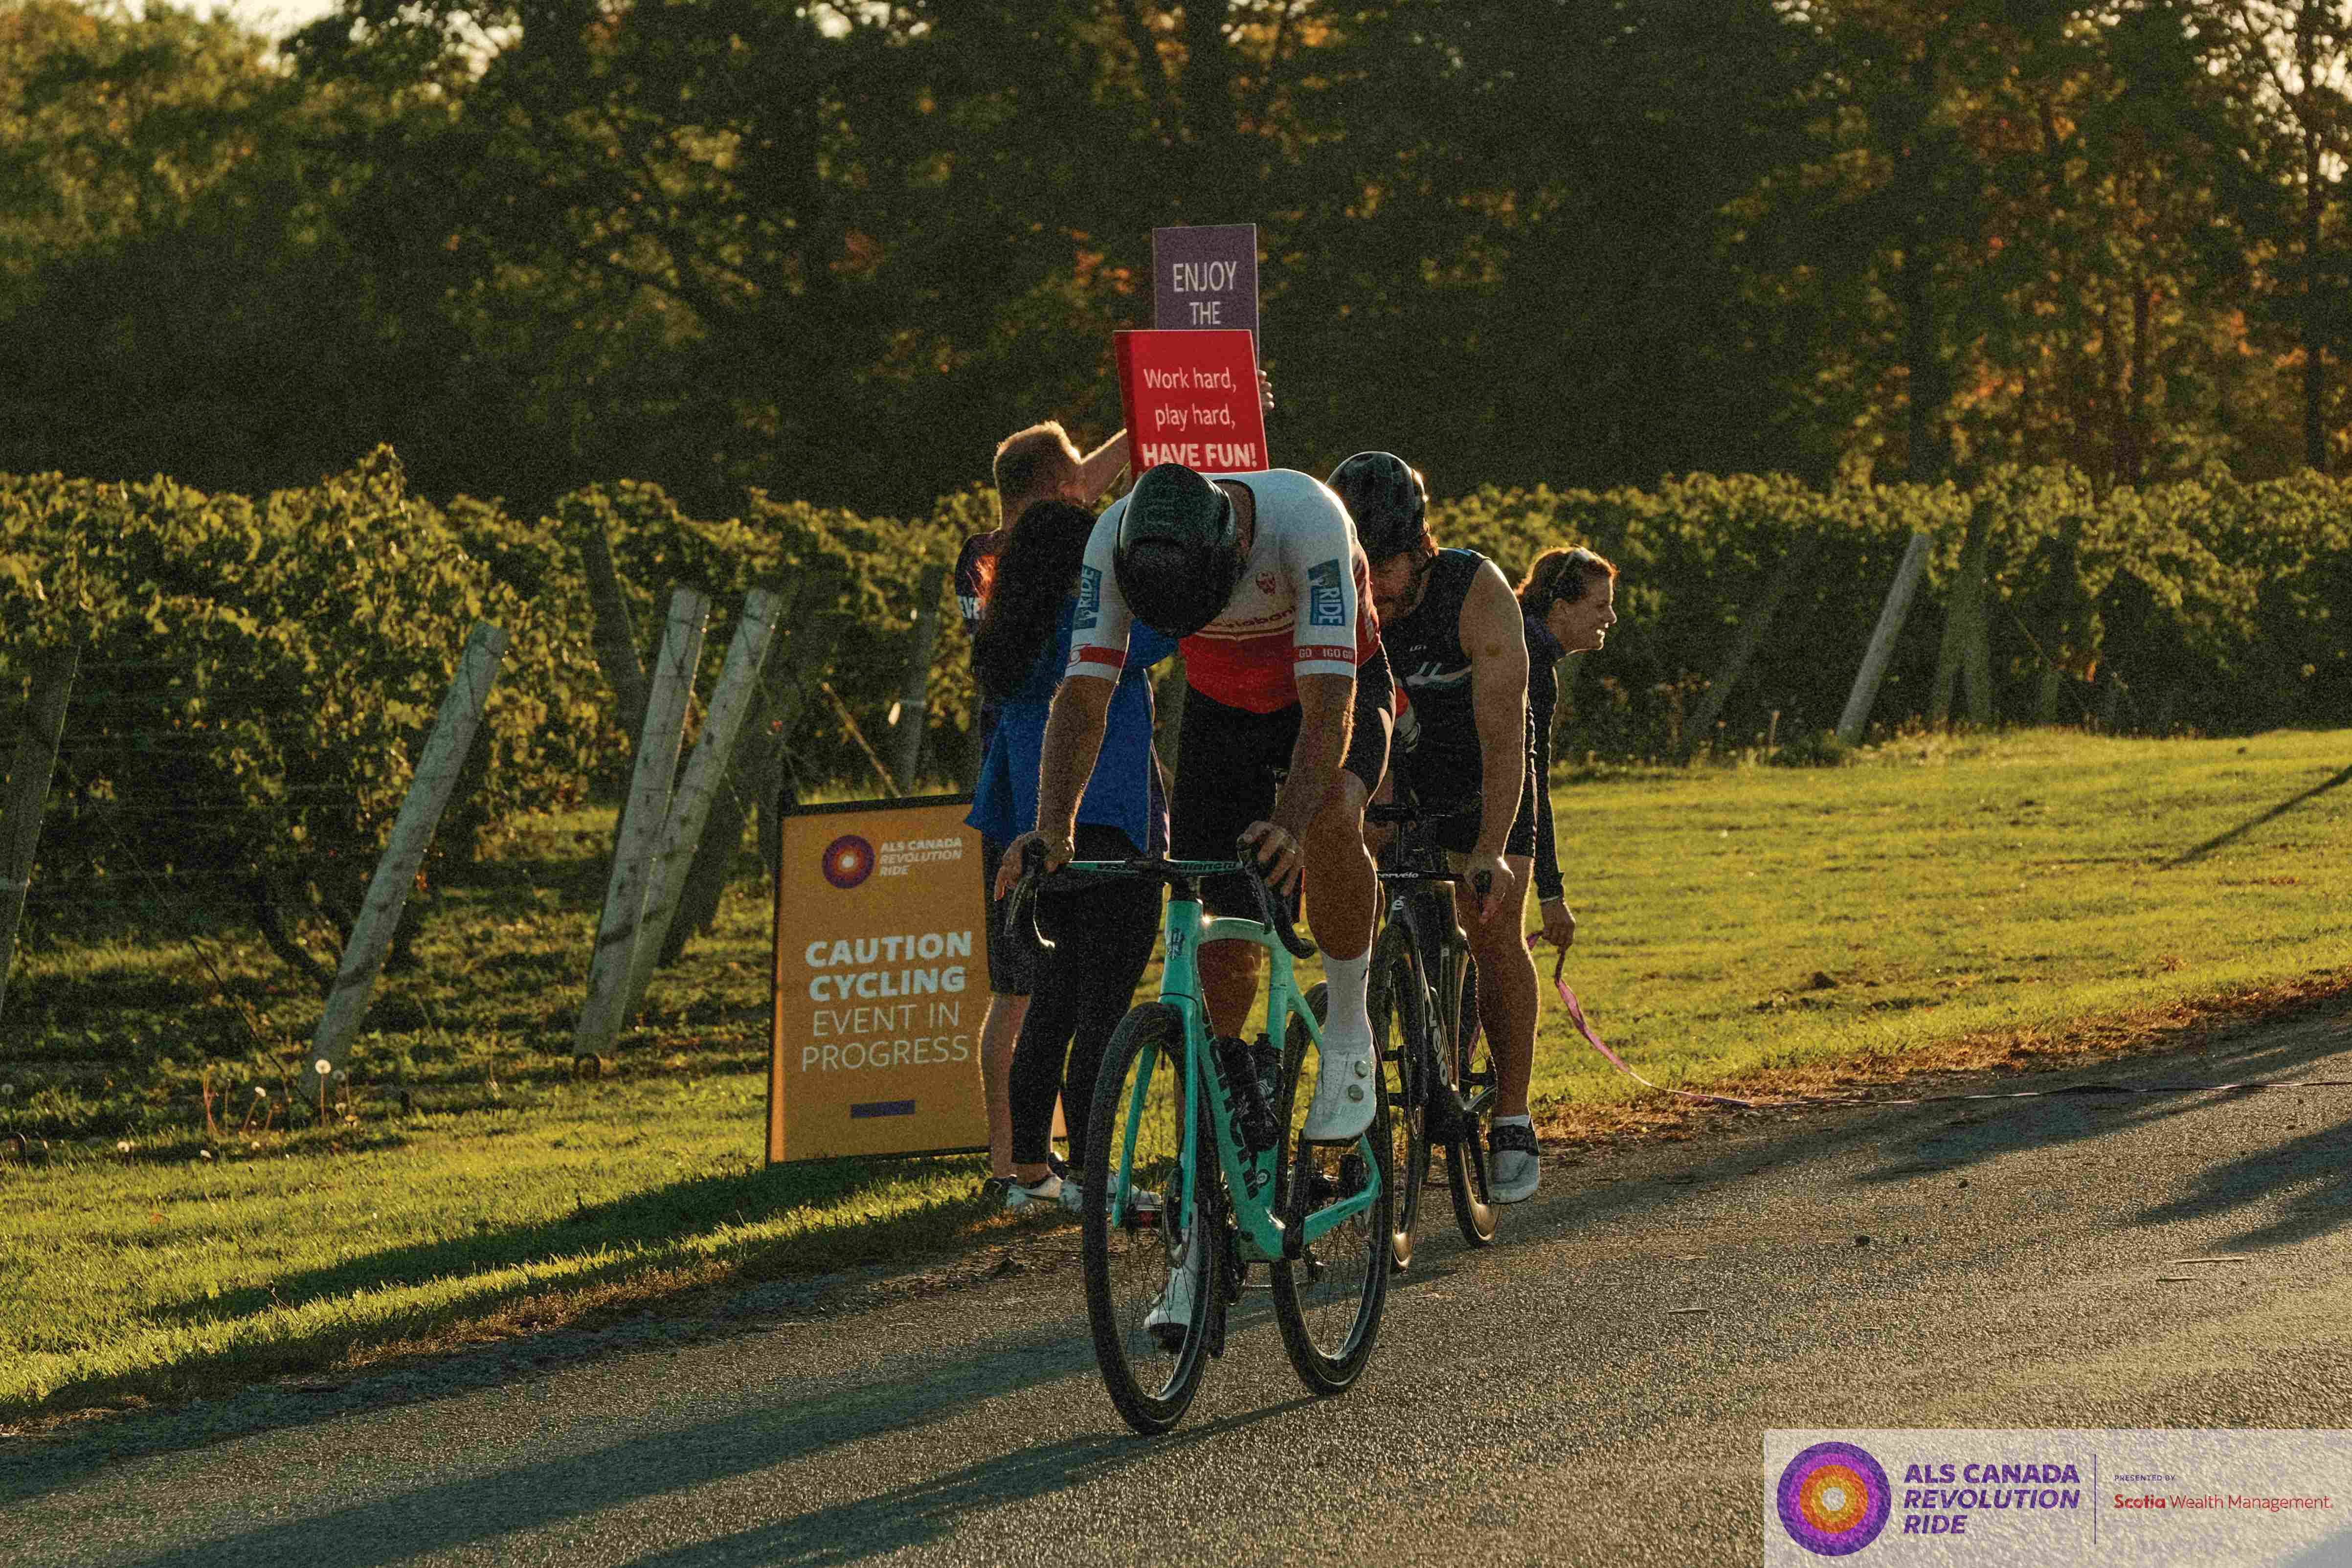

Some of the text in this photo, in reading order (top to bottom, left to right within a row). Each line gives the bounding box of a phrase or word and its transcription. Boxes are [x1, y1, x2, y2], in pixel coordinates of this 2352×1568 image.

[1173, 261, 1237, 292] ENJOY
[1189, 301, 1221, 325] THE
[1143, 367, 1237, 393] Work hard,
[1155, 403, 1236, 432] play hard,
[1142, 443, 1257, 467] HAVE FUN!
[1318, 587, 1344, 625] RIDE
[880, 837, 963, 852] ALS CANADA
[880, 850, 963, 865] REVOLUTION
[880, 865, 911, 876] RIDE
[806, 931, 971, 968] CAUTION
[809, 966, 966, 1002] CYCLING
[813, 1002, 959, 1037] EVENT IN
[802, 1034, 970, 1073] PROGRESS
